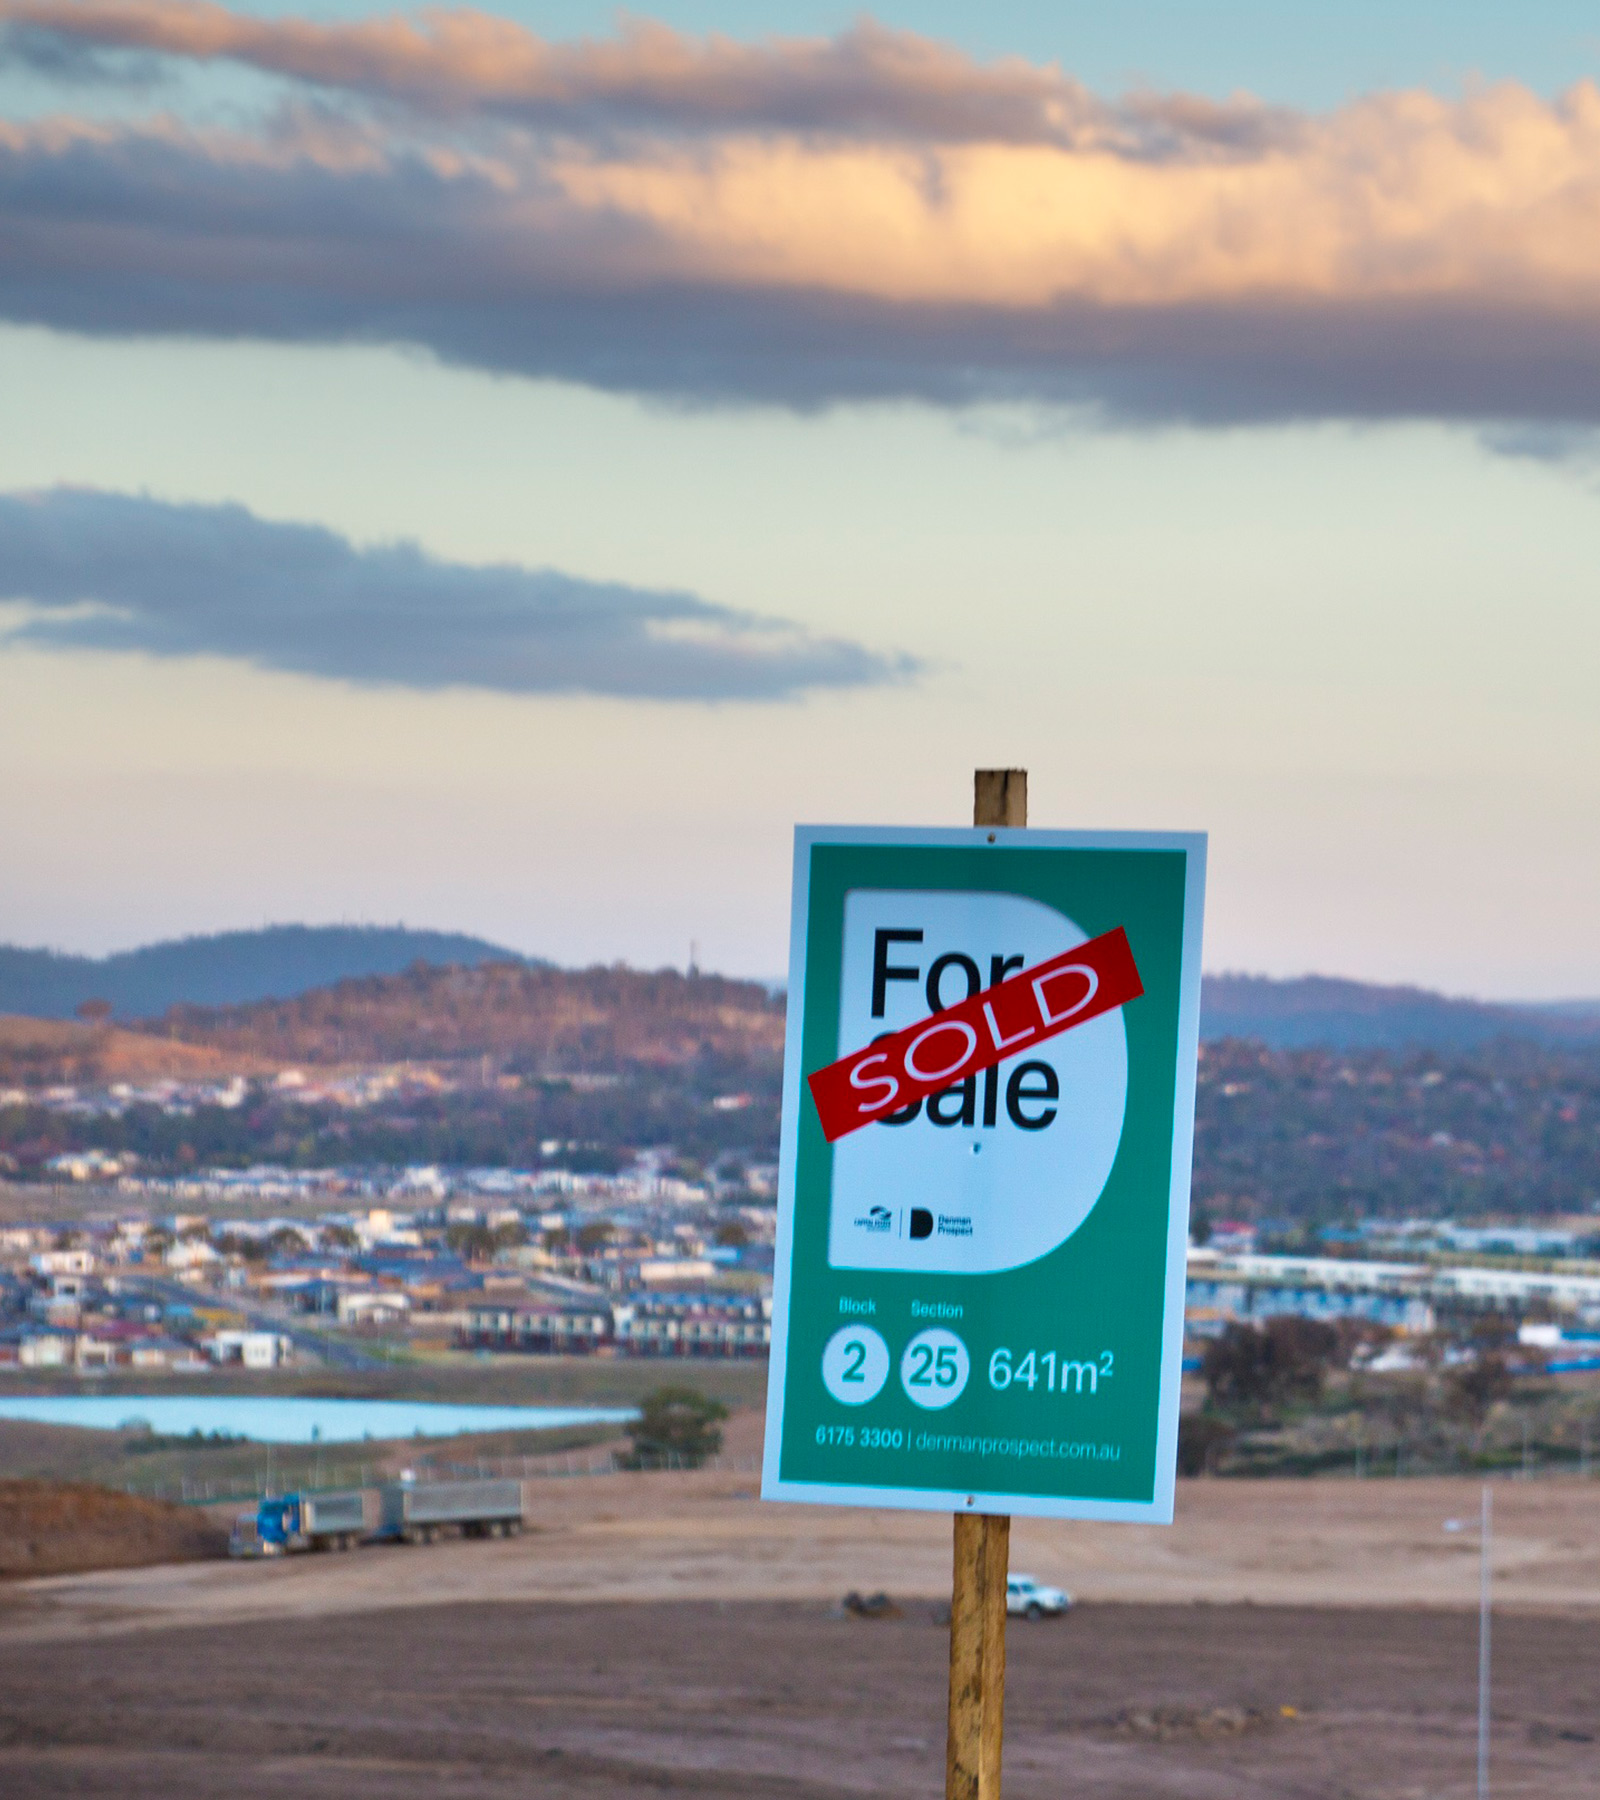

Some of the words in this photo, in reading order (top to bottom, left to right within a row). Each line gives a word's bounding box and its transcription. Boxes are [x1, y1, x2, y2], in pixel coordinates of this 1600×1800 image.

[850, 964, 1099, 1112] SOLD
[839, 1296, 876, 1315] Block
[911, 1299, 963, 1318] Section
[841, 1340, 866, 1383] 2
[909, 1343, 958, 1388] 25
[988, 1346, 1114, 1394] 641m²
[815, 1424, 854, 1446] 6175
[860, 1427, 903, 1449] 3300
[916, 1431, 1121, 1461] denmanprospect.com.au
